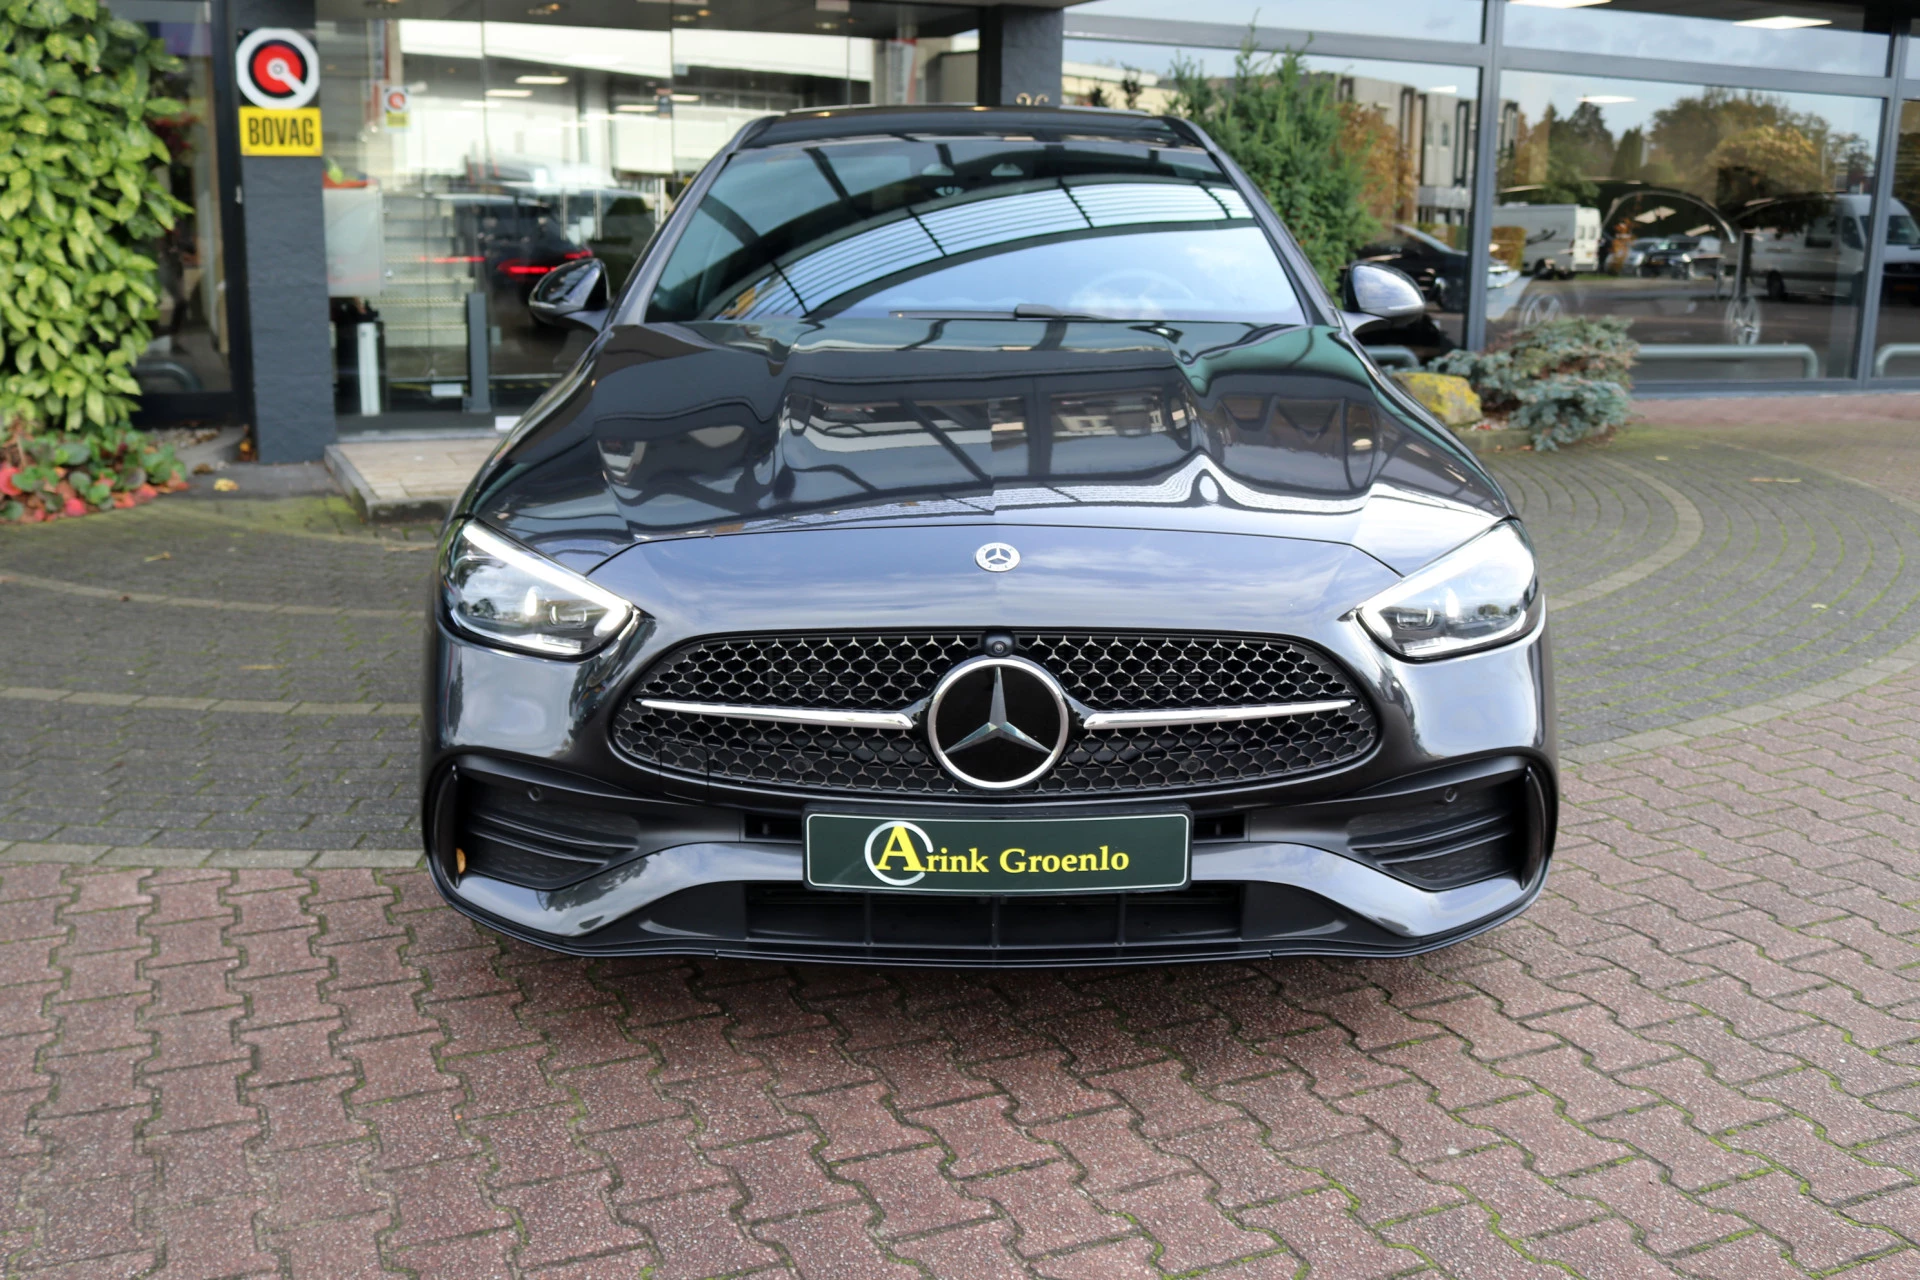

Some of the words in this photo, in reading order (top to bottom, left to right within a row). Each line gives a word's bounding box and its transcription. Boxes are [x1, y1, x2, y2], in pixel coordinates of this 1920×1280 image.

[248, 117, 314, 146] BOVAG
[874, 825, 989, 873] Arink
[999, 845, 1130, 873] Groenlo
